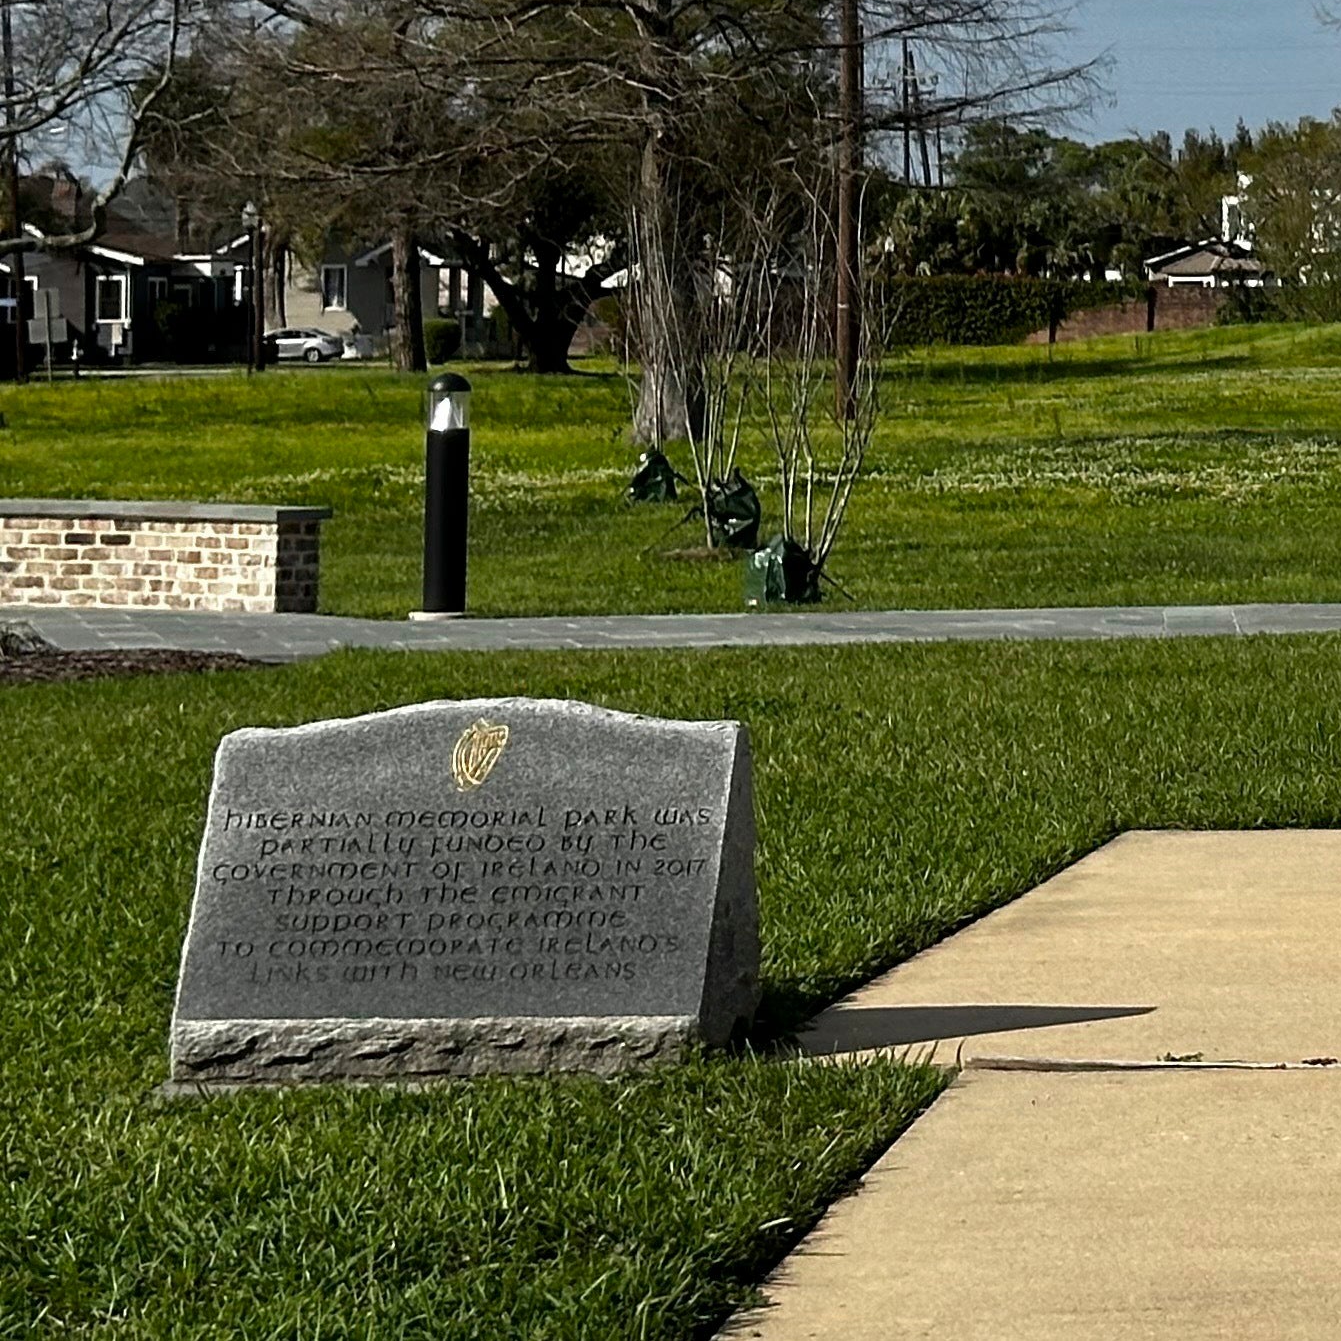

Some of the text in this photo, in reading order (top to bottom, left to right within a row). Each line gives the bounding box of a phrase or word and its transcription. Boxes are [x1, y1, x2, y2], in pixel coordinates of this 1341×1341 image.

[565, 805, 638, 831] PARK
[654, 808, 711, 826] WAS
[561, 835, 593, 856] BY
[611, 830, 667, 851] THE
[616, 859, 640, 875] IN
[653, 859, 706, 876] 2017
[421, 883, 478, 905] THE
[218, 940, 254, 957] TO
[434, 963, 496, 982] NEW
[510, 959, 636, 981] ORLEANS
